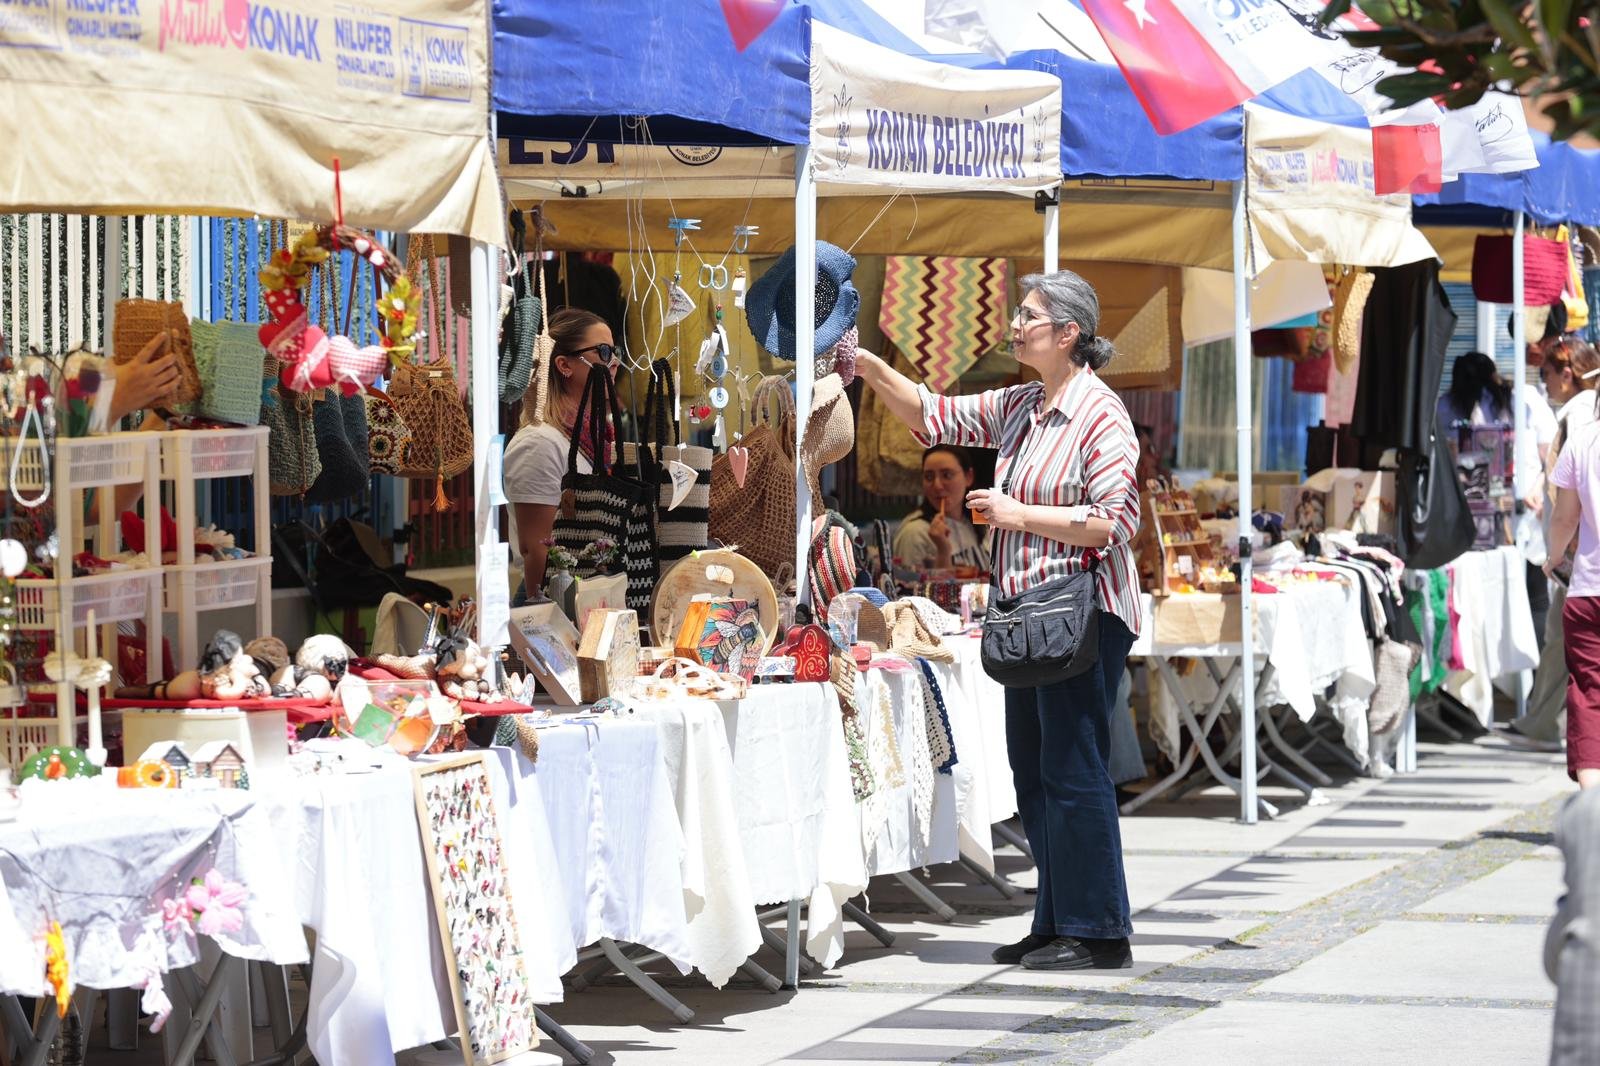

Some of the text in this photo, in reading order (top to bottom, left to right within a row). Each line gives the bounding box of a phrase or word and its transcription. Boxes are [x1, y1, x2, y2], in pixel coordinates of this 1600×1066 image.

[246, 3, 322, 62] KONAK
[426, 37, 465, 66] KONAK
[866, 104, 1027, 179] KONAK BELEDİYESİ
